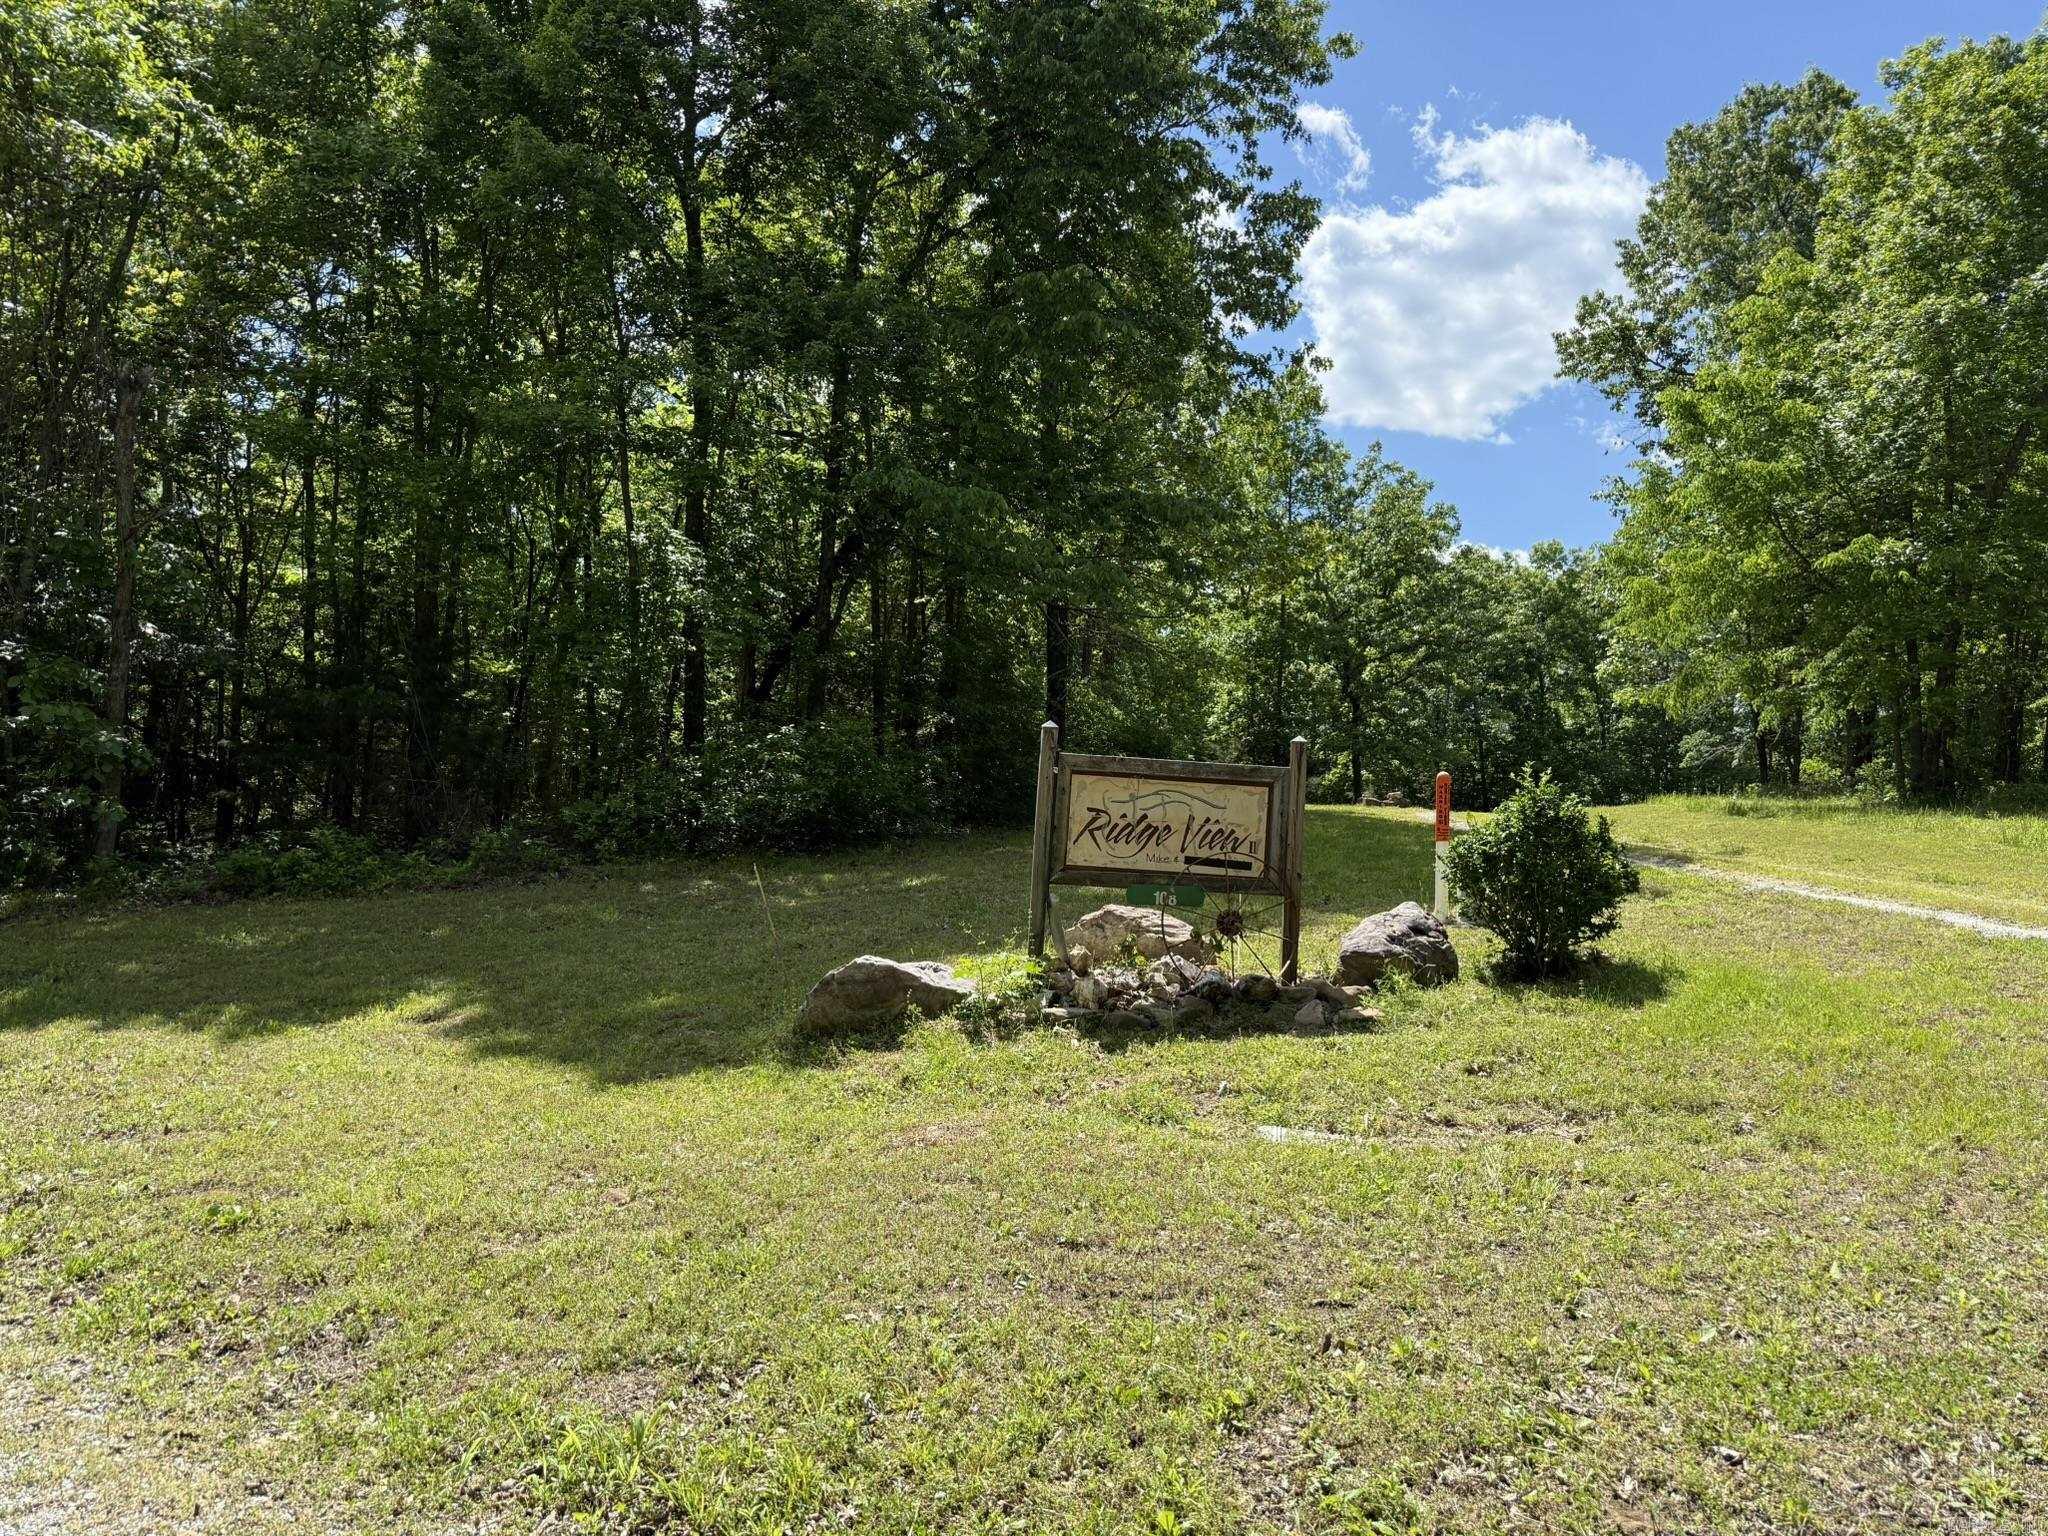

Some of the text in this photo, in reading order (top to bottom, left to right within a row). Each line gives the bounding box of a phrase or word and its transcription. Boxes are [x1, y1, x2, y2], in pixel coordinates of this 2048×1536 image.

[1073, 807, 1178, 858] Ridge
[1180, 814, 1251, 854] View
[1146, 853, 1171, 865] Mike
